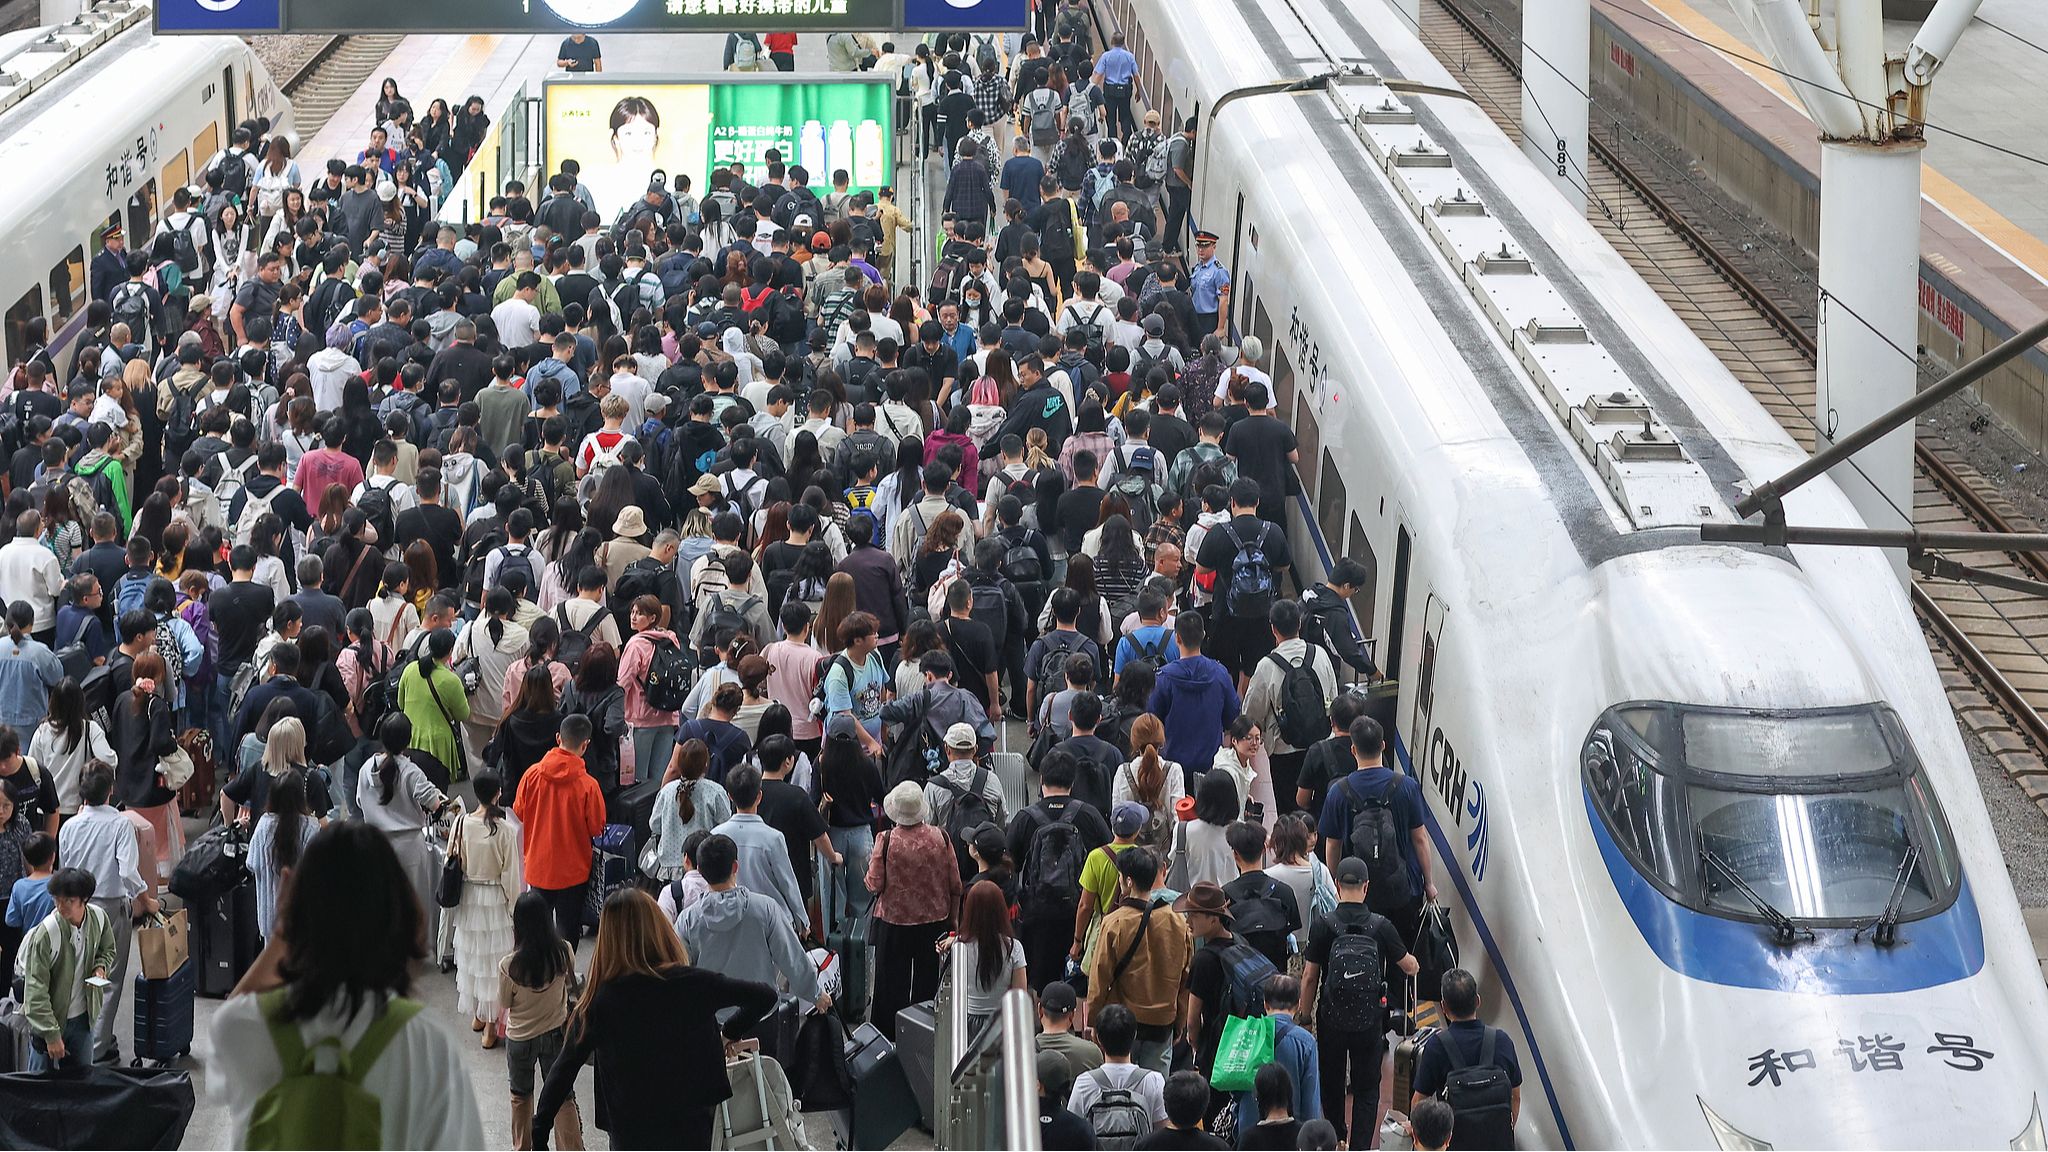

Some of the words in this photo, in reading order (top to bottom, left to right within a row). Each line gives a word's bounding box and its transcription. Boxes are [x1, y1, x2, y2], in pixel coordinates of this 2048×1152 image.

[713, 126, 727, 136] A2
[713, 139, 793, 163] 更好蛋白
[105, 135, 148, 200] 和谐号
[1557, 139, 1567, 177] 088
[1289, 305, 1320, 394] 和谐号
[1046, 396, 1061, 409] NIKE
[1430, 727, 1467, 828] CRH
[1747, 1032, 1995, 1087] 和谐号
